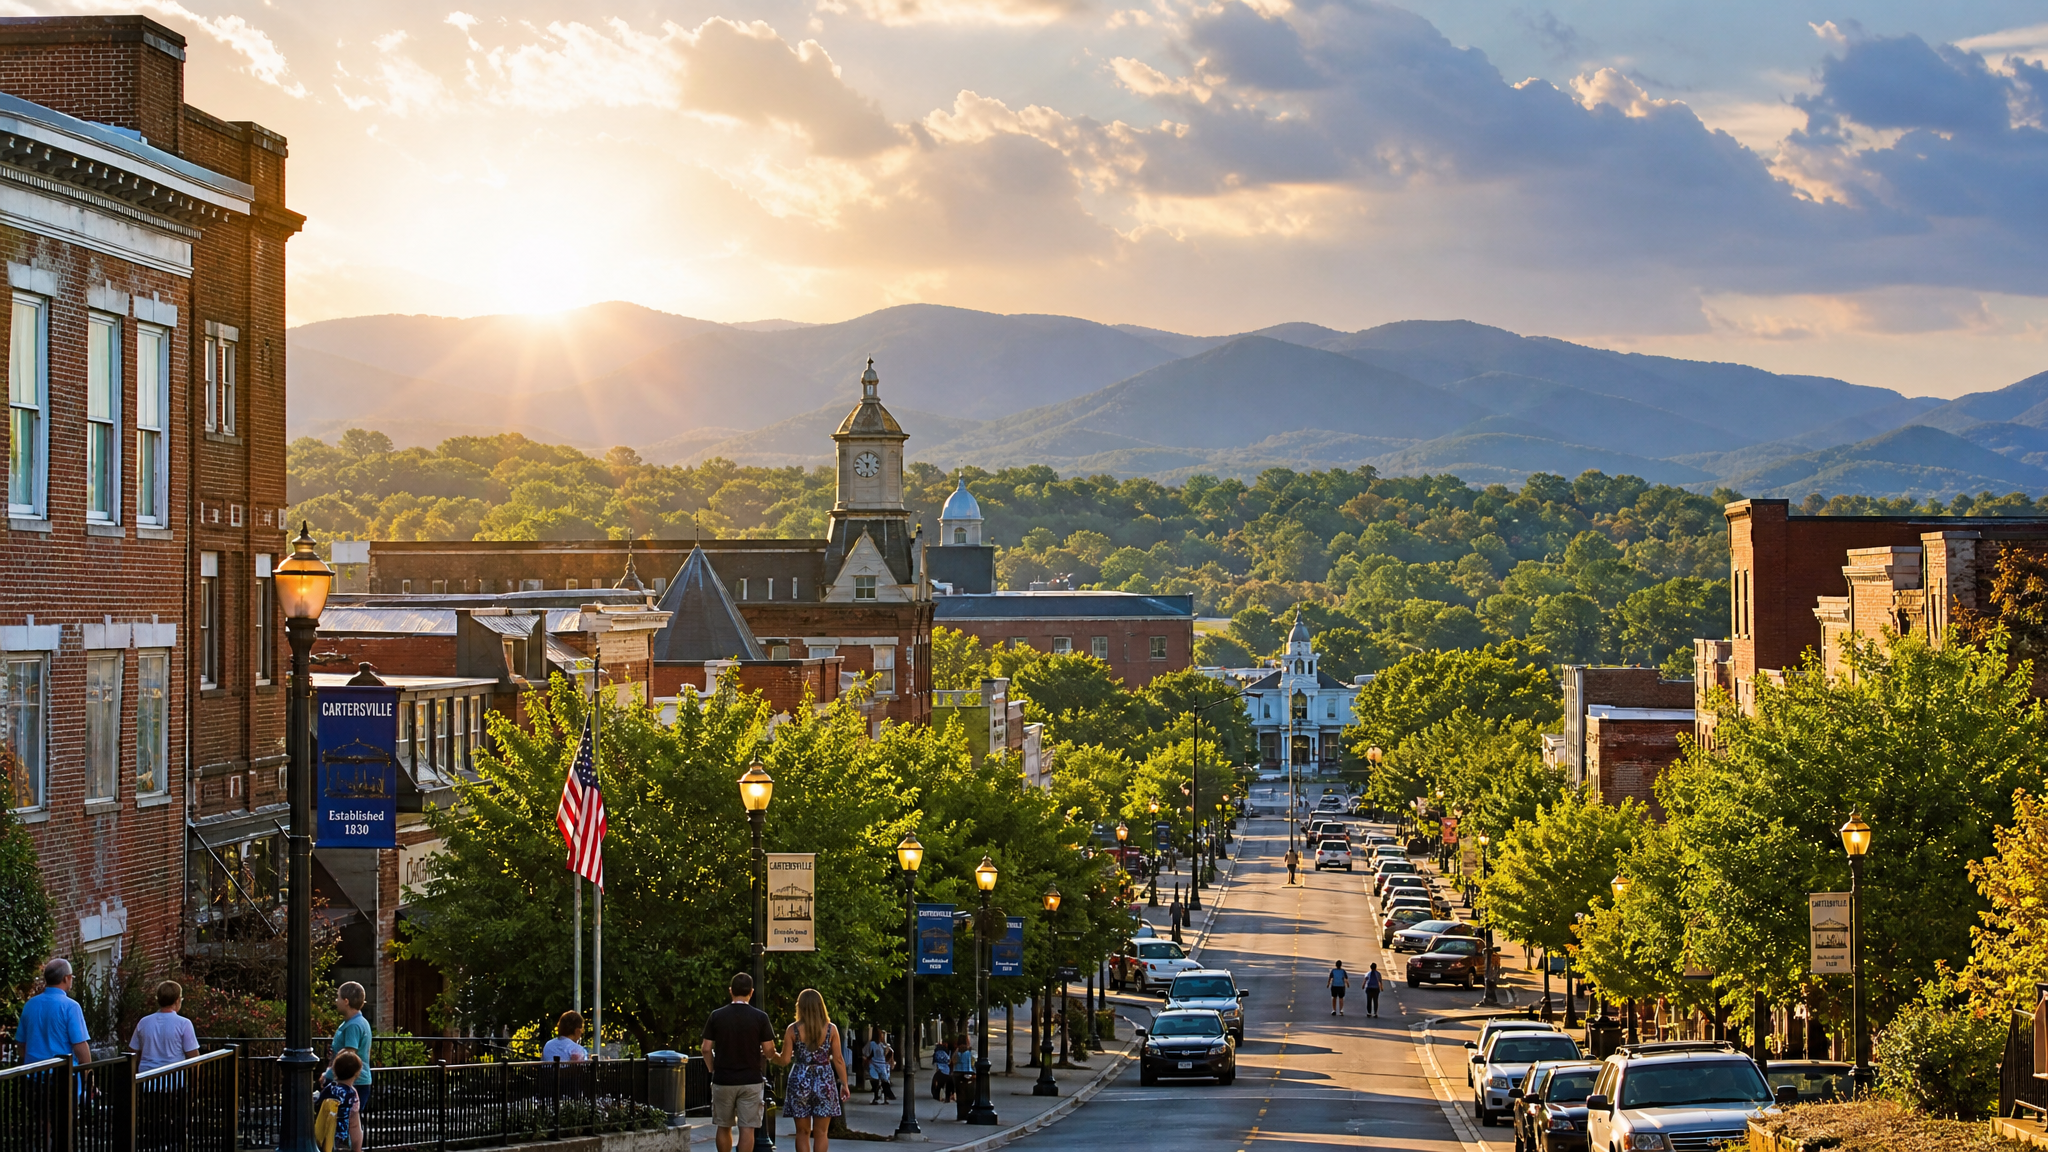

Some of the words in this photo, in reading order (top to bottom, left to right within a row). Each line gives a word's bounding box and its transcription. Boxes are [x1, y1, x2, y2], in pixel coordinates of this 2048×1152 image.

[322, 702, 393, 717] CARTERSVILLE
[329, 810, 385, 821] Established
[345, 824, 369, 835] 1830
